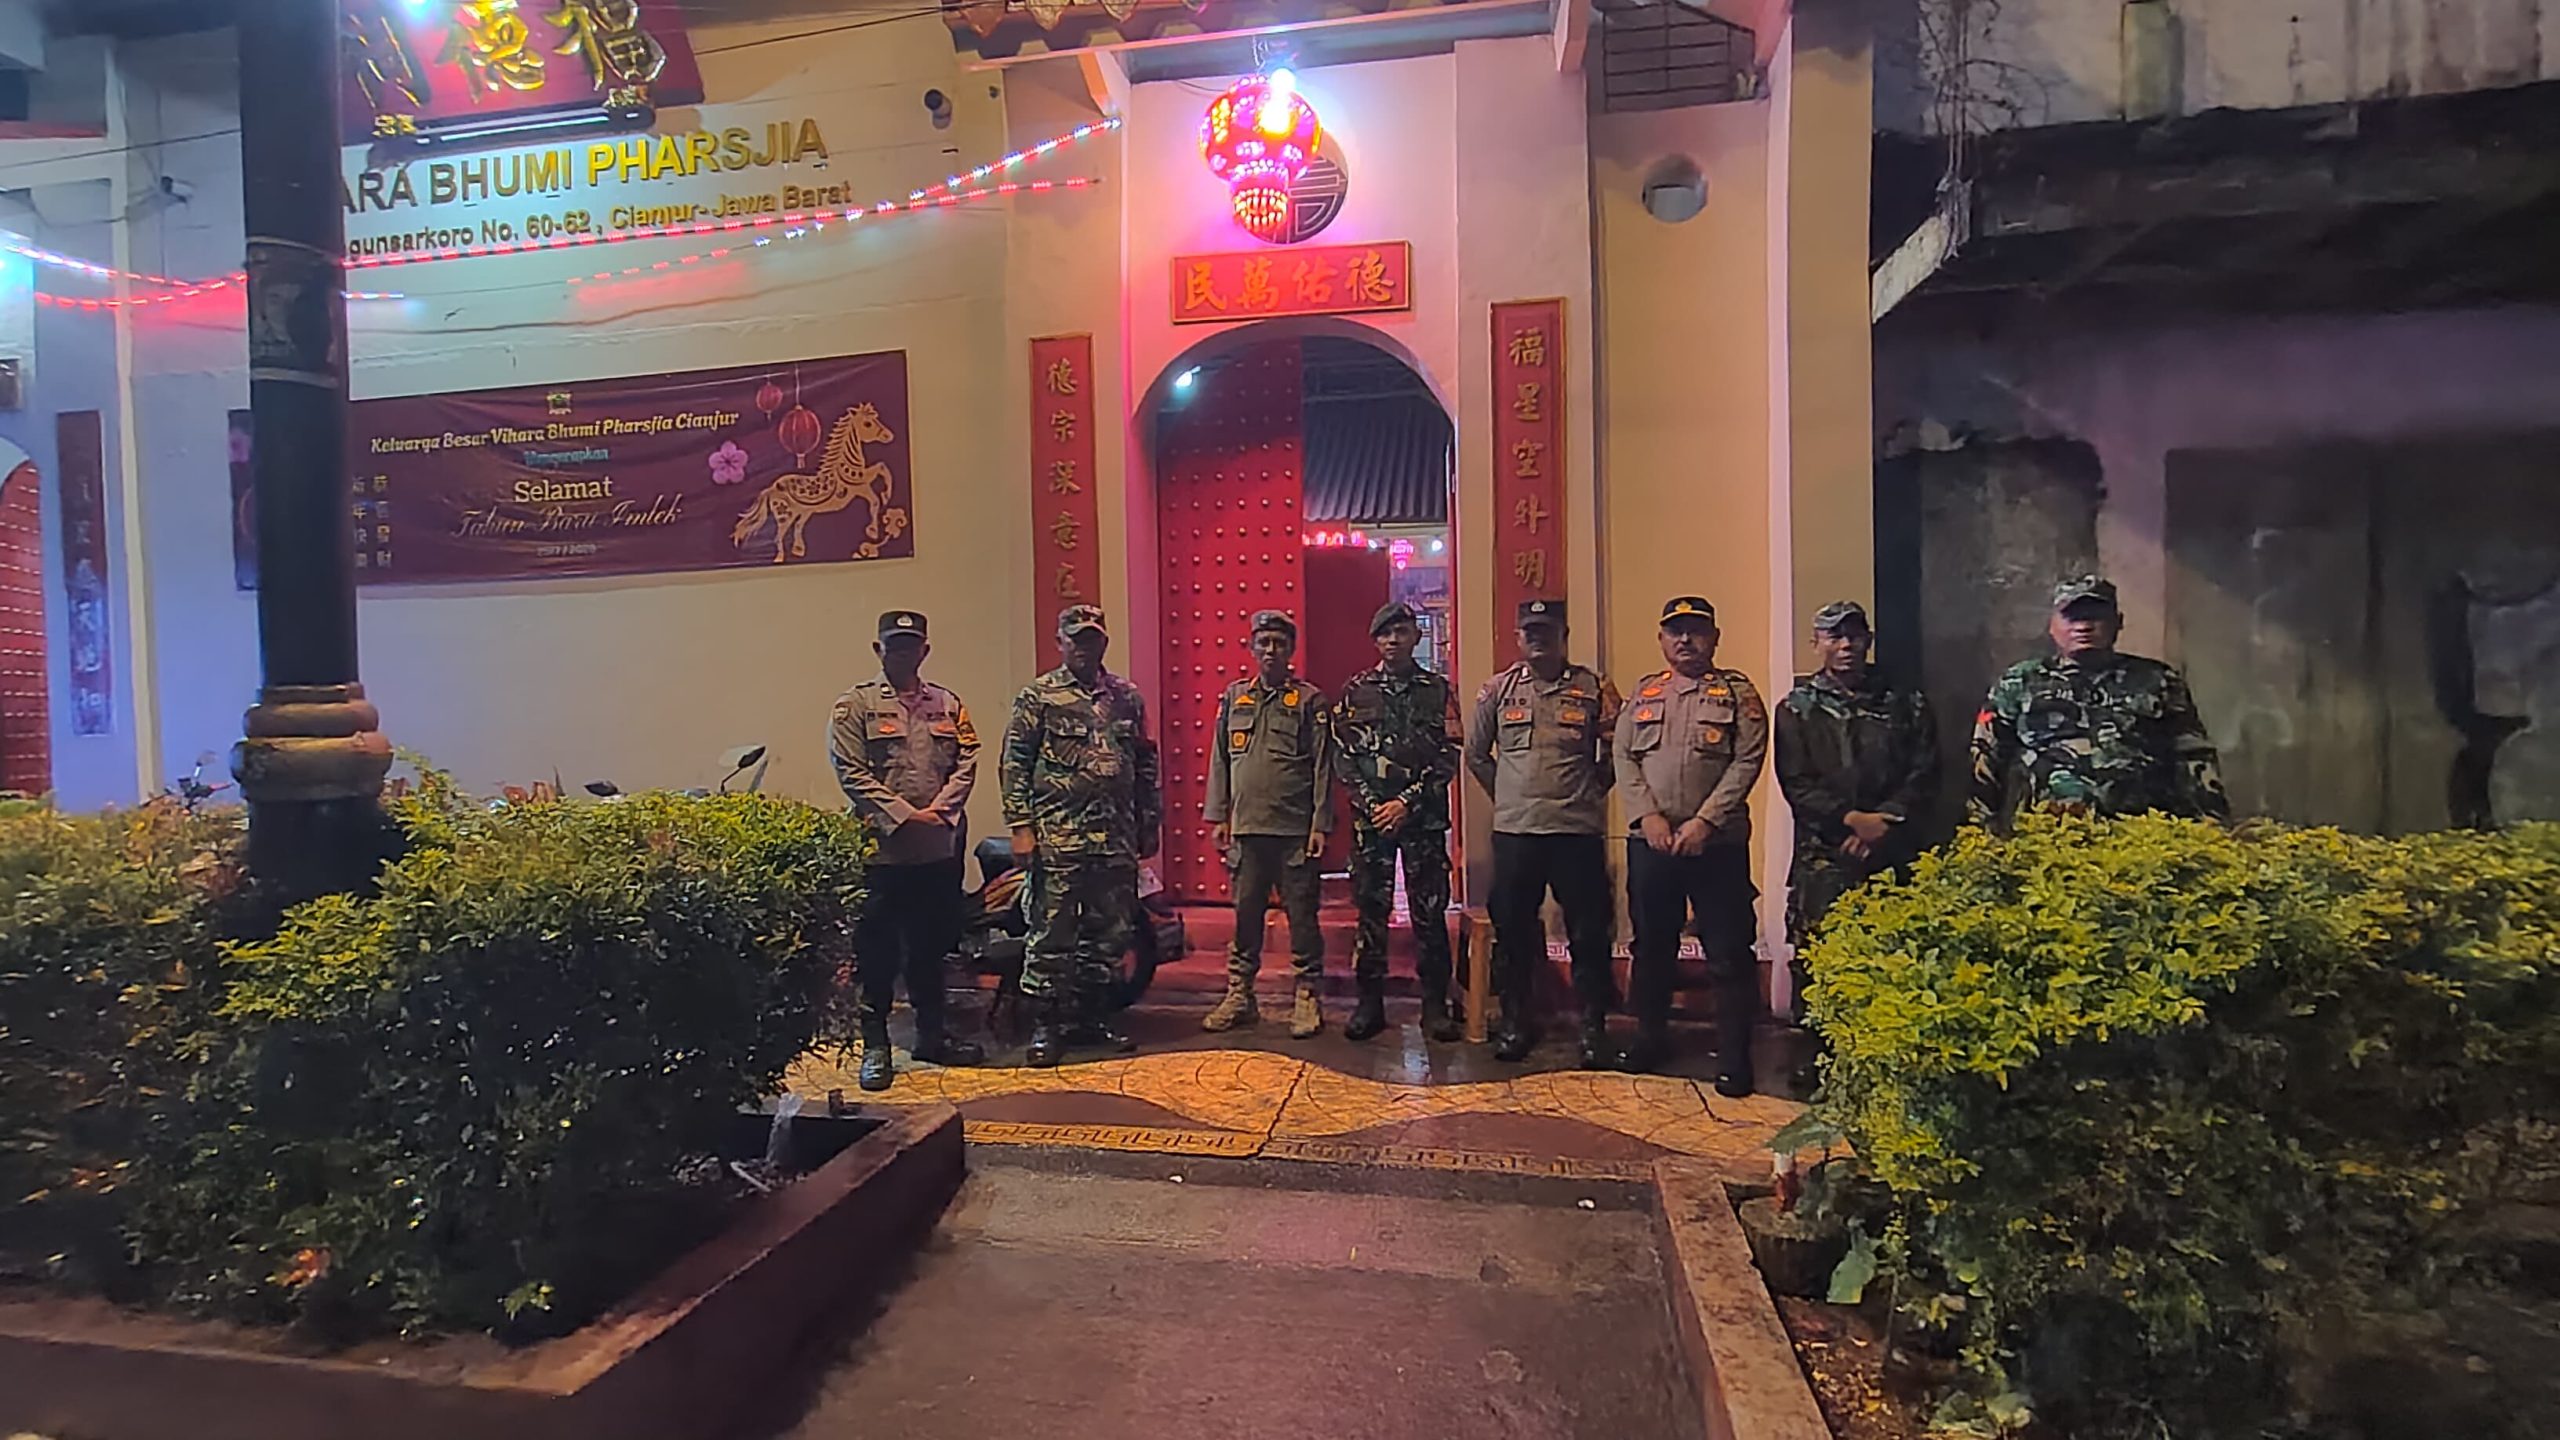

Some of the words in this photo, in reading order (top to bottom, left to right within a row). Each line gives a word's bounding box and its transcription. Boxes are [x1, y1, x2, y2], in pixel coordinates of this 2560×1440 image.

[341, 168, 418, 214] ARA
[429, 149, 572, 205] BHUMI
[588, 118, 829, 186] PHARSJIA
[348, 226, 475, 262] gunsarkoro
[481, 218, 519, 244] No.
[782, 180, 853, 210] Barat
[371, 437, 440, 454] Keluarga
[443, 432, 490, 448] Besar
[490, 427, 545, 445] Vihara
[547, 420, 601, 439] Bhumi
[602, 414, 673, 436] Pharsjia
[675, 410, 740, 432] Cianjur
[514, 476, 613, 502] Selamat
[451, 505, 525, 538] Tahun
[531, 506, 597, 533] Baru
[604, 493, 682, 527] Imlek
